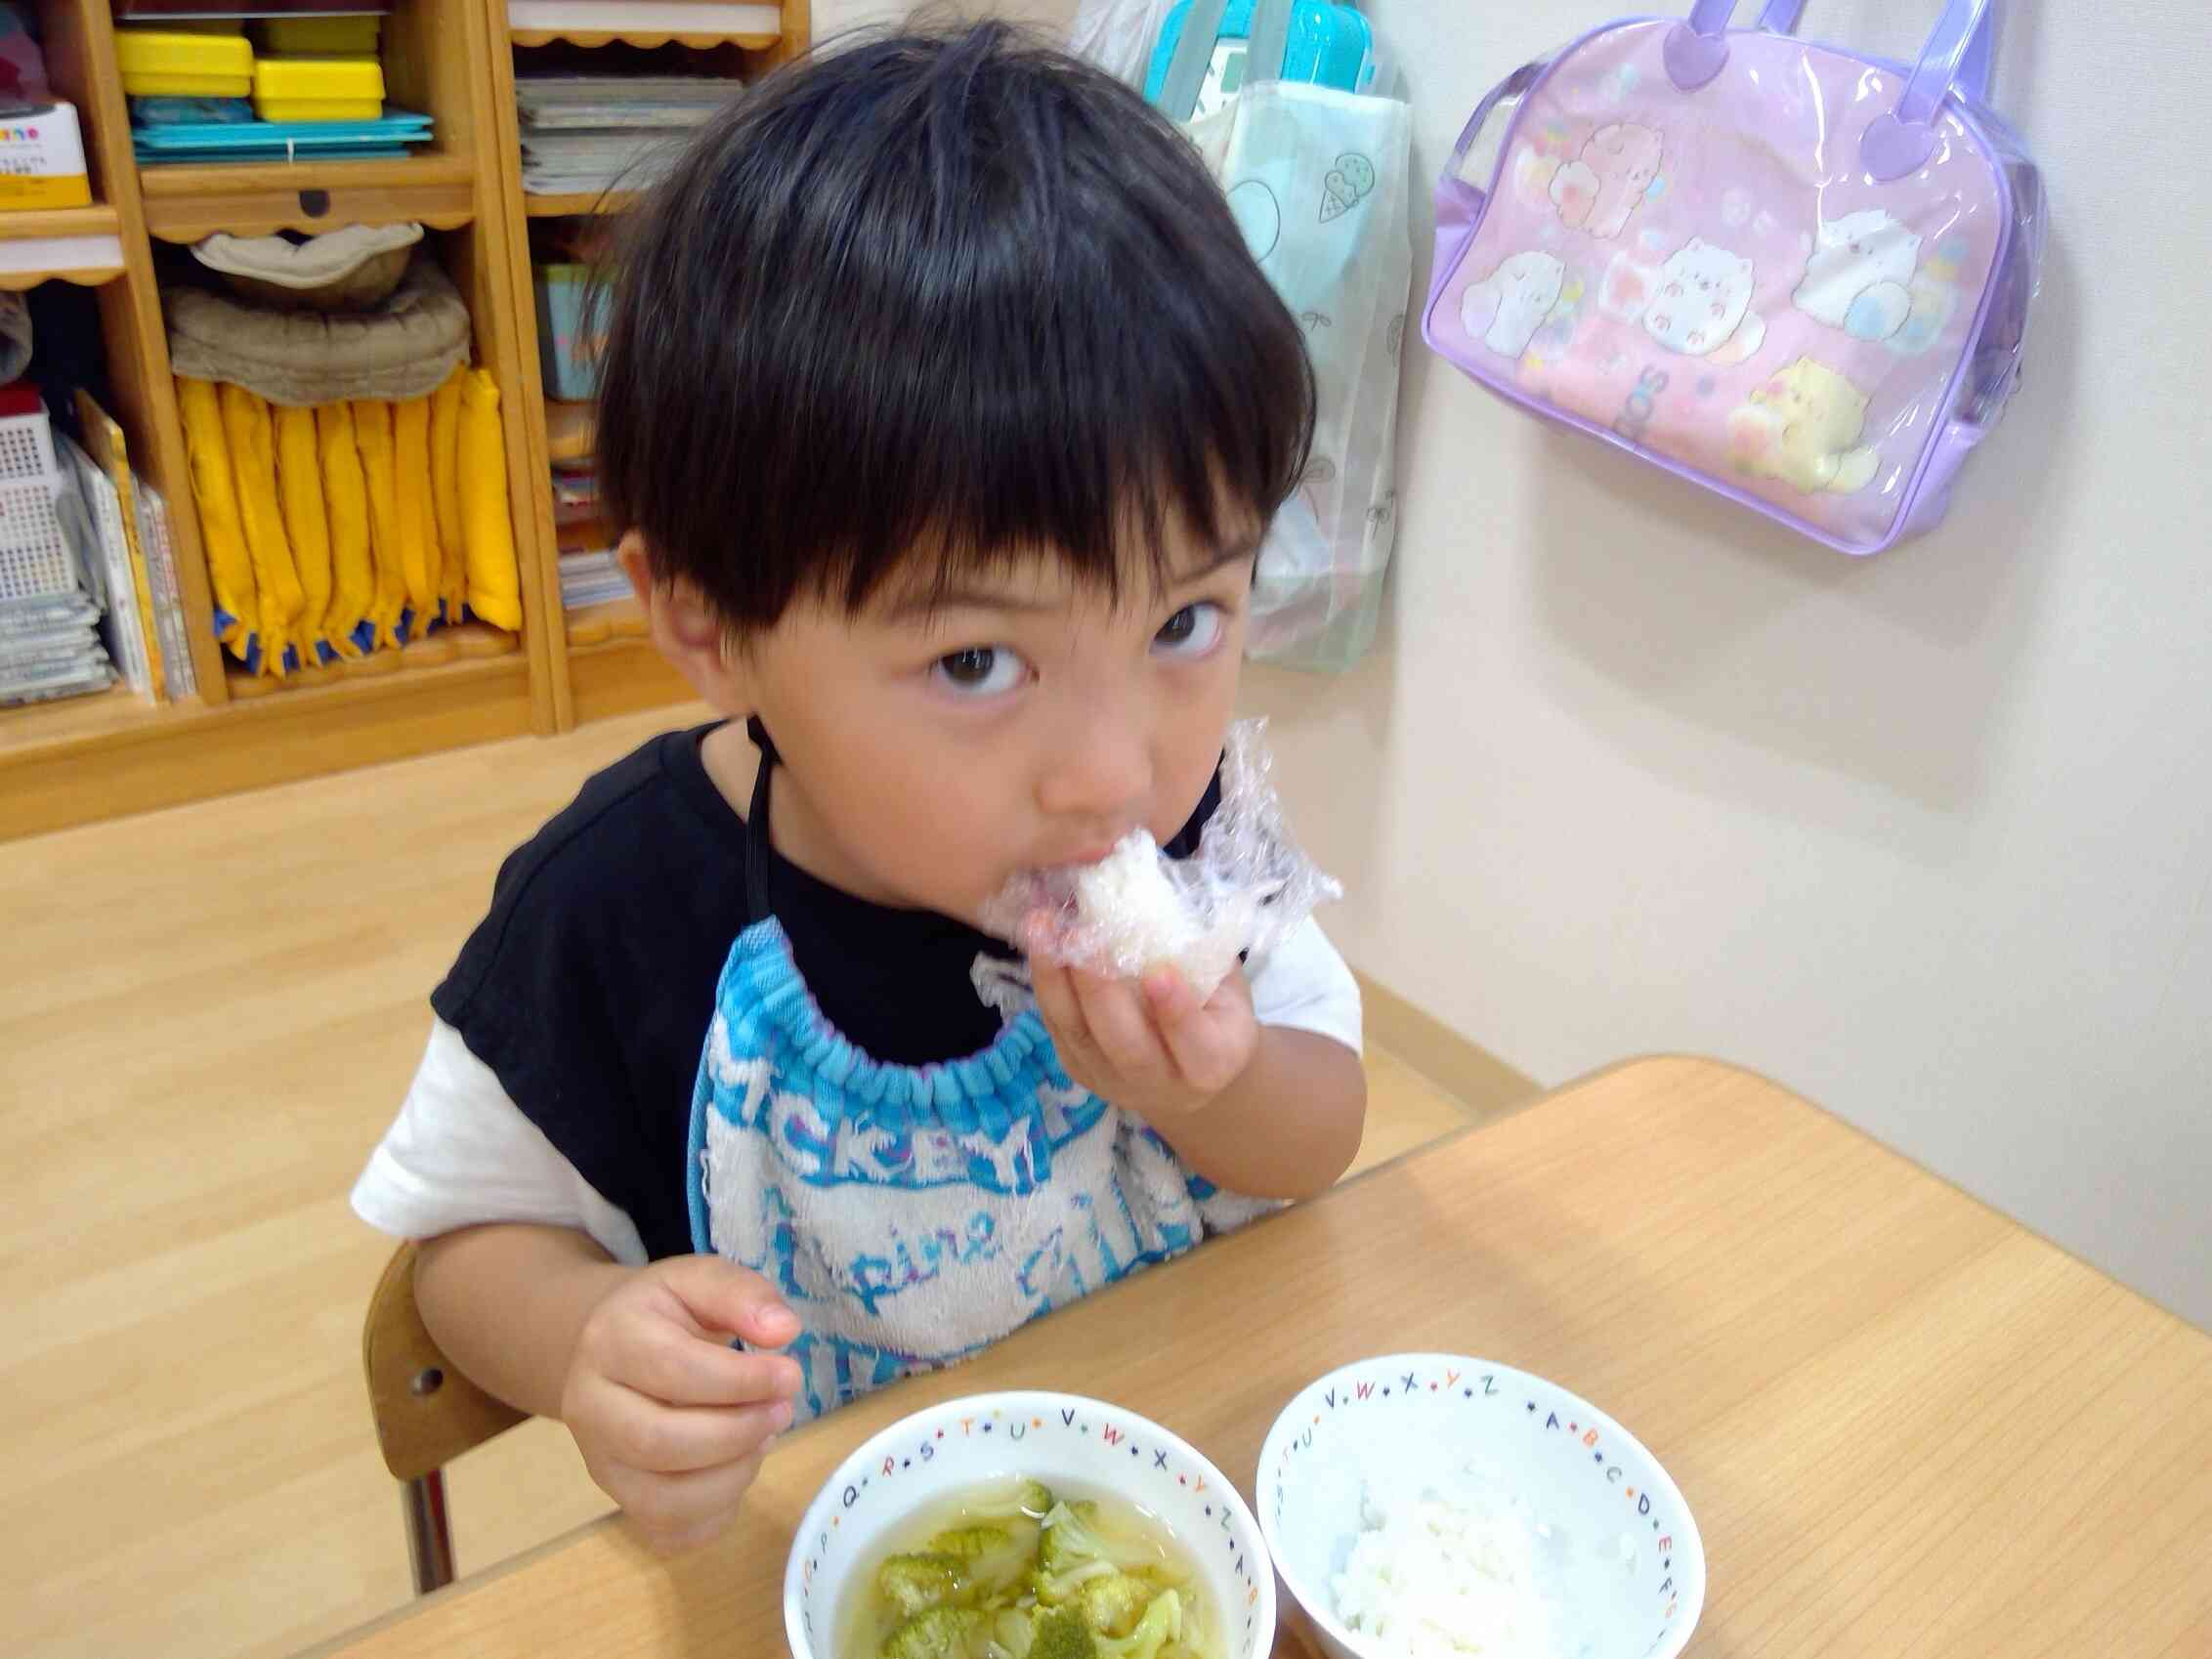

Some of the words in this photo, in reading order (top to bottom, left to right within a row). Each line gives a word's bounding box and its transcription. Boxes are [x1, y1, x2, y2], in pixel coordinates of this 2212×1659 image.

[1400, 1372, 1419, 1394] X
[1447, 1368, 1462, 1389] Y
[1480, 1374, 1500, 1396] Z
[1325, 1386, 1336, 1410] V
[1356, 1380, 1376, 1400] W
[1546, 1411, 1560, 1429] A
[1582, 1427, 1599, 1448] B
[843, 1485, 860, 1510] Q
[882, 1456, 895, 1477] R
[919, 1440, 935, 1462] S
[961, 1418, 975, 1437] T
[1010, 1422, 1026, 1441] U
[1061, 1408, 1076, 1427] V
[1103, 1423, 1125, 1446] W
[1154, 1448, 1169, 1470] X
[1606, 1466, 1623, 1483] C
[1638, 1492, 1650, 1515] D
[1658, 1535, 1673, 1553] E
[1658, 1576, 1673, 1595] F
